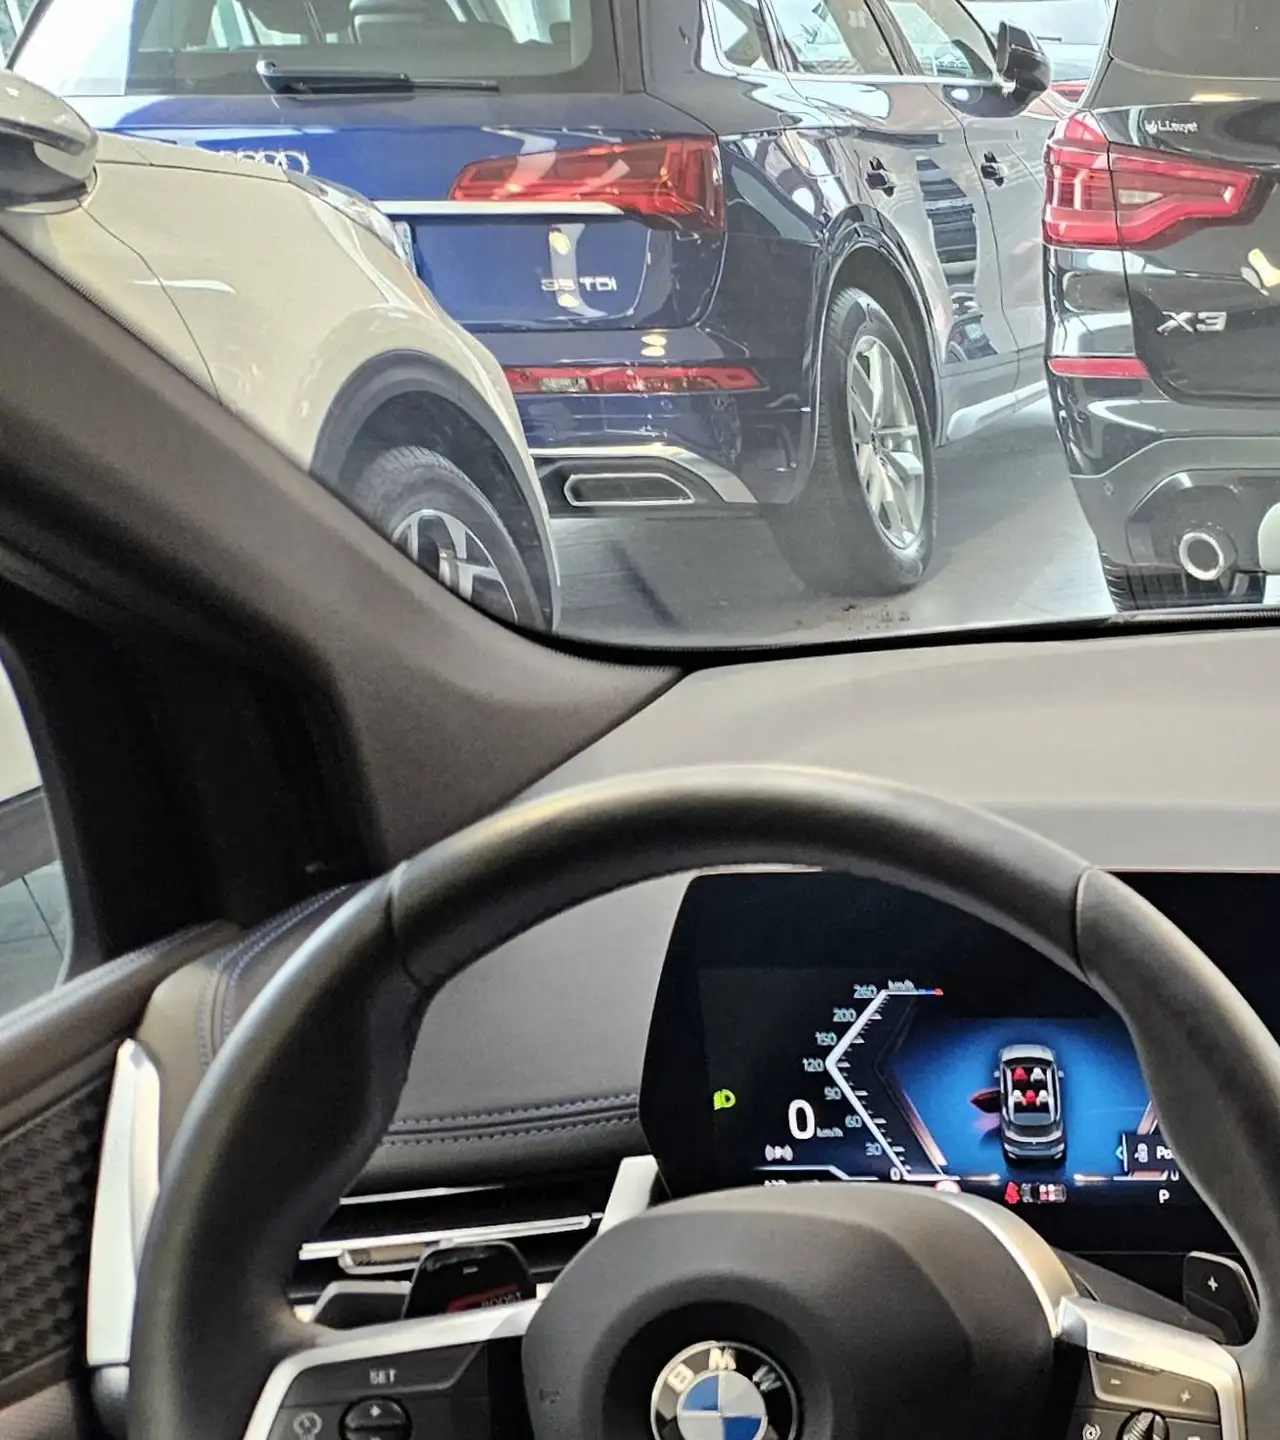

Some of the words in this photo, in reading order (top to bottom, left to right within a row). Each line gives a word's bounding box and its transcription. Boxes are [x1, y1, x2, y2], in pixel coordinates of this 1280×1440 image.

[579, 276, 617, 291] TDI
[1156, 310, 1228, 335] X3
[832, 1007, 857, 1022] 200
[815, 1031, 837, 1045] 150
[802, 1058, 824, 1072] 120
[788, 1099, 815, 1140] 0
[845, 1115, 862, 1128] 60
[865, 1143, 882, 1156] 30
[1158, 1189, 1170, 1204] P
[369, 1368, 397, 1384] SET
[667, 1347, 783, 1394] BMW
